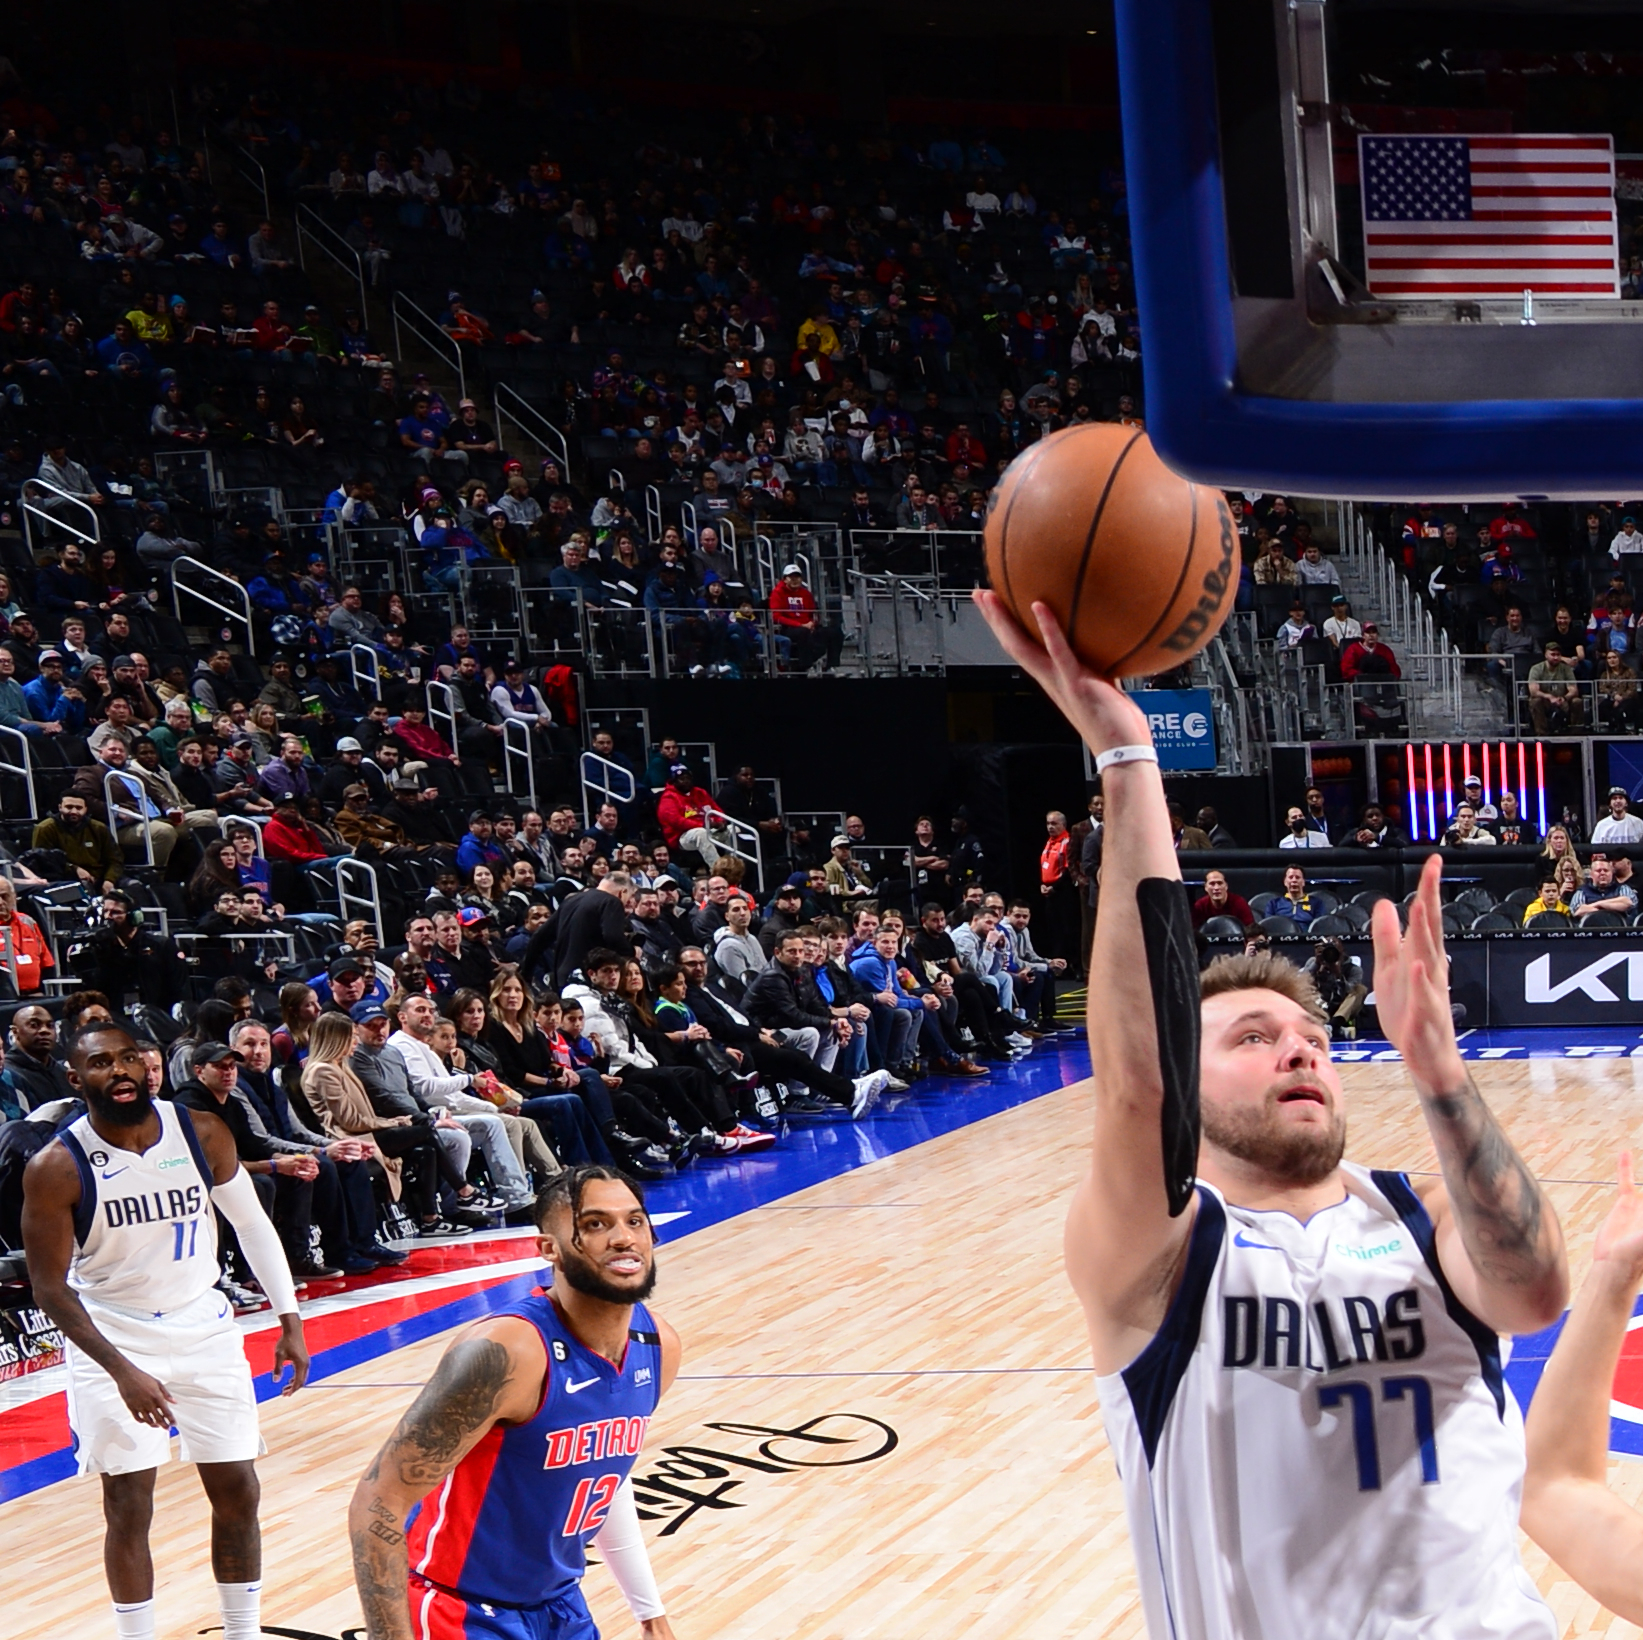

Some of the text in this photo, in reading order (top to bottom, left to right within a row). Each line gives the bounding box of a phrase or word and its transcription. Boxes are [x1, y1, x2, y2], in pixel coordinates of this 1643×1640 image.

[93, 1152, 106, 1167] 6
[158, 1155, 190, 1170] chime
[103, 1185, 201, 1229] DALLAS
[171, 1218, 199, 1262] 11
[1335, 1238, 1403, 1261] chime
[552, 1340, 566, 1361] 6
[1222, 1286, 1426, 1375] DALLAS
[1316, 1373, 1441, 1492] 77
[562, 1473, 623, 1538] 12
